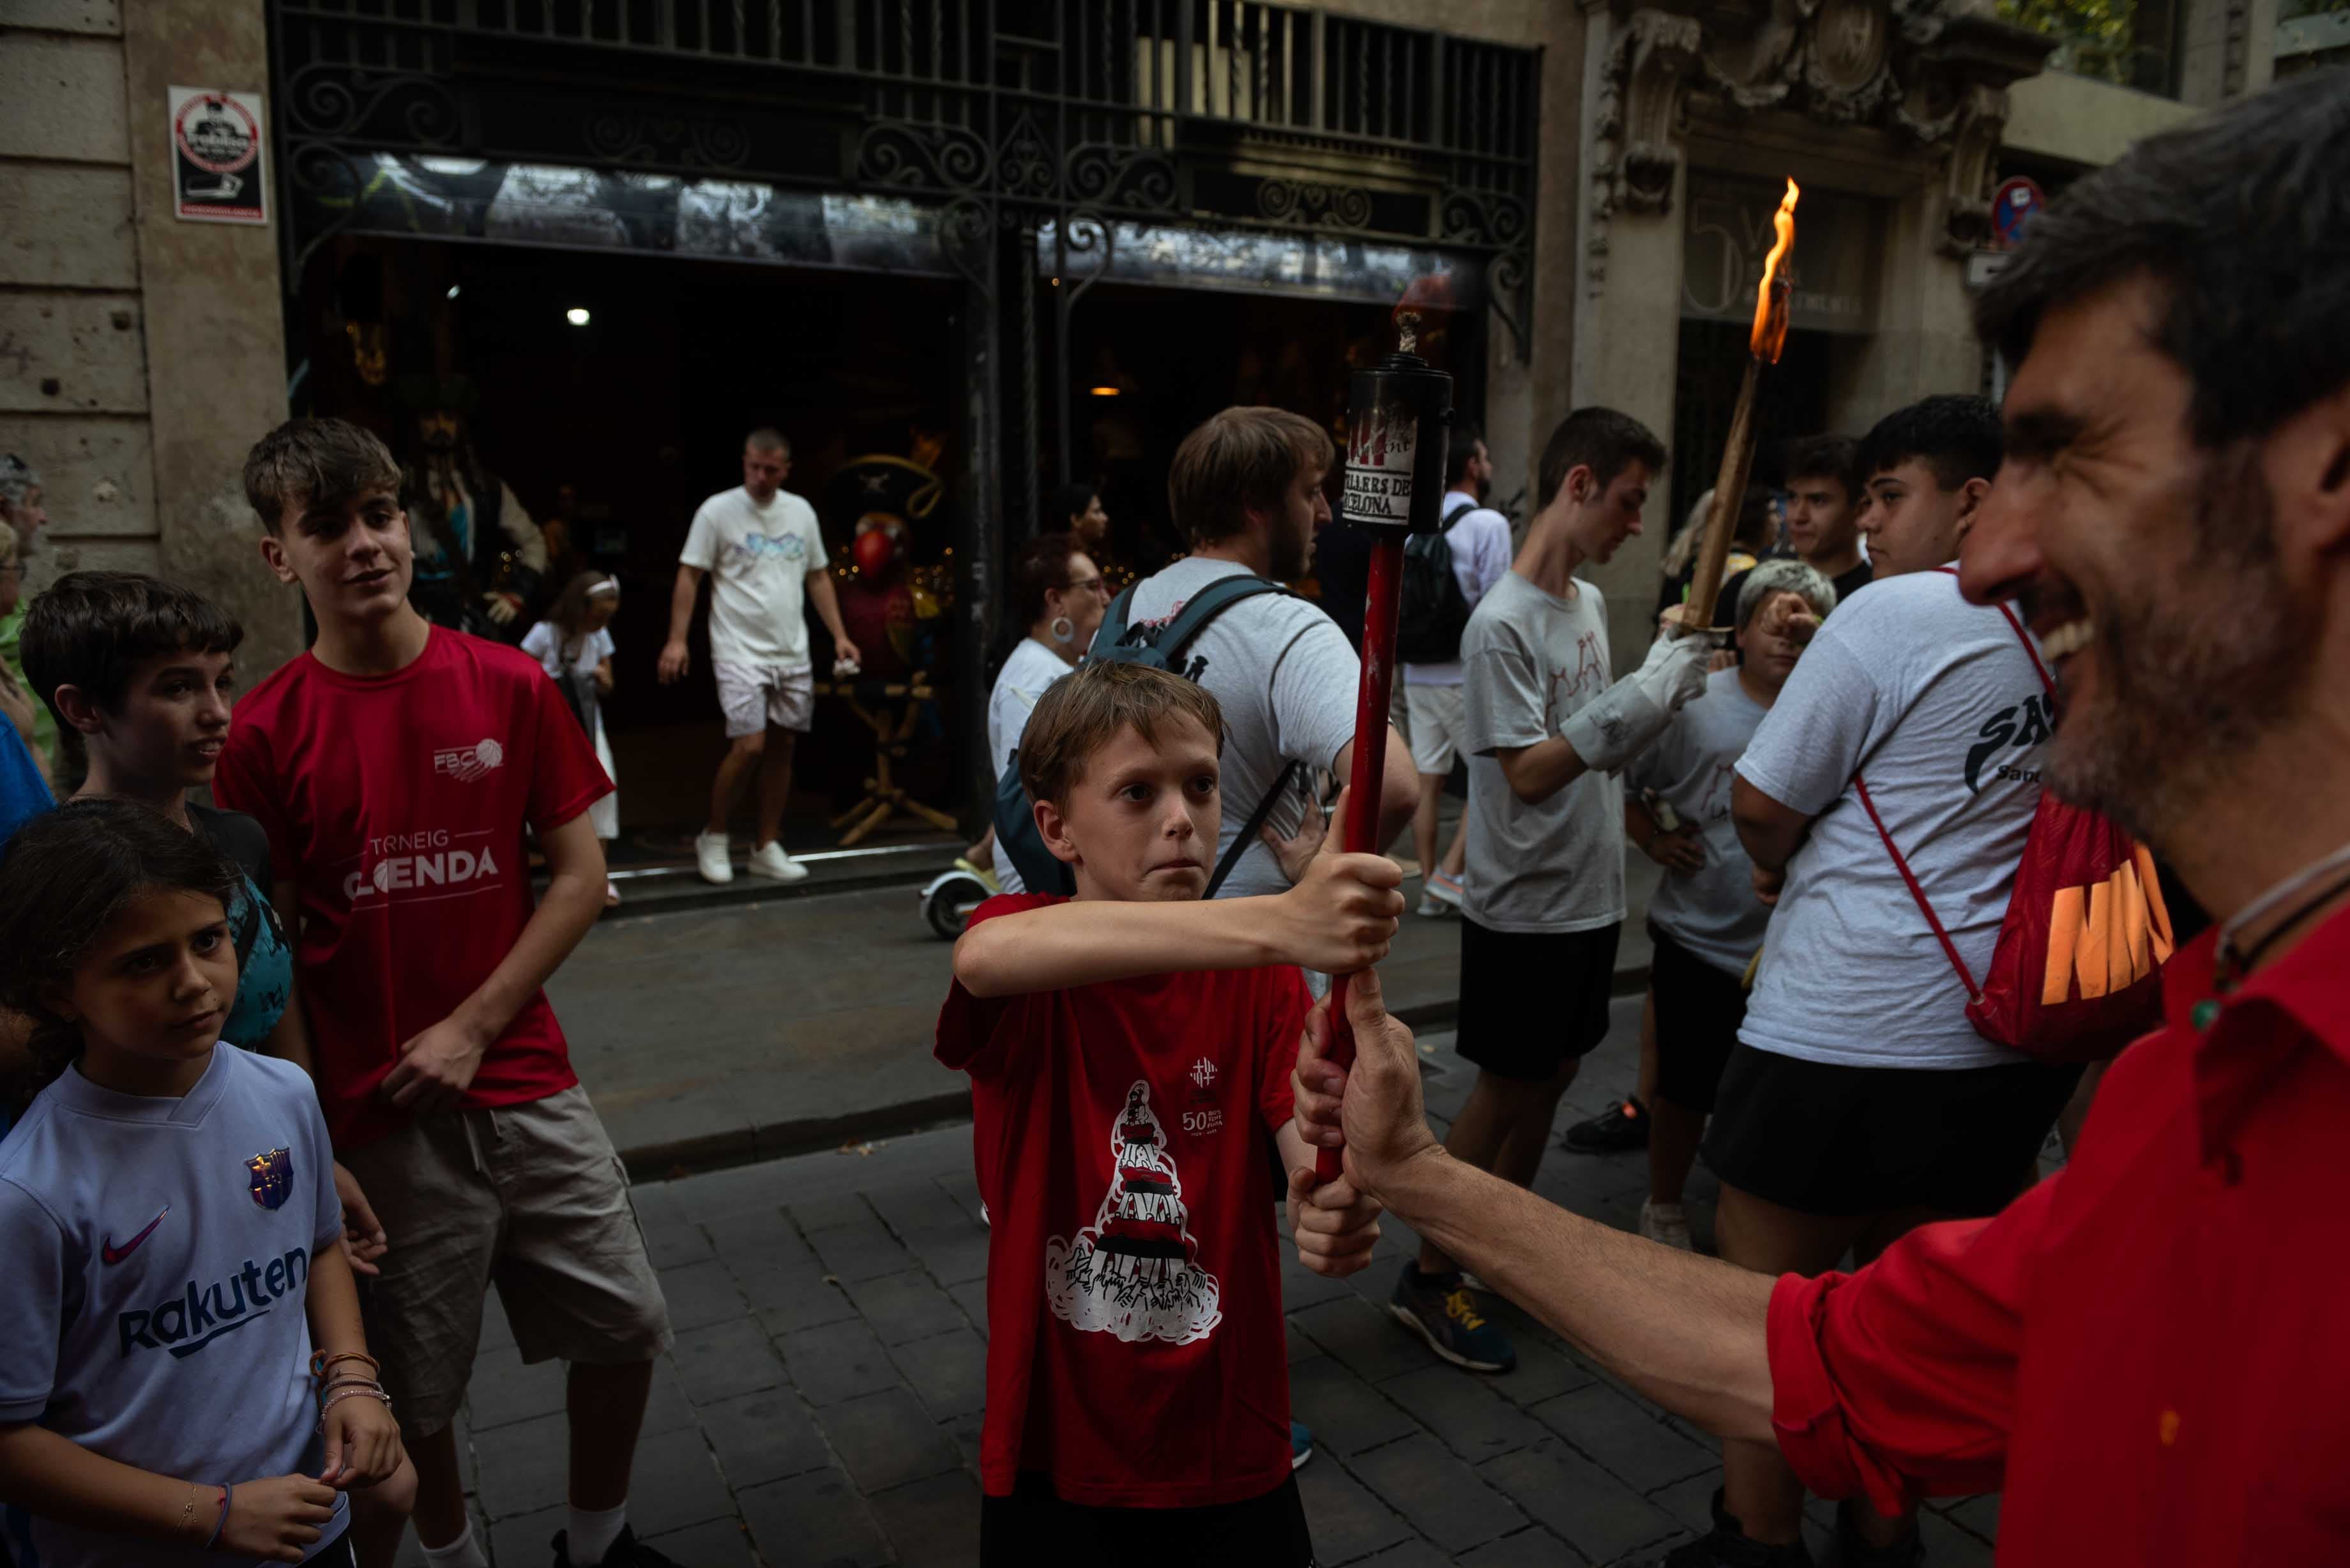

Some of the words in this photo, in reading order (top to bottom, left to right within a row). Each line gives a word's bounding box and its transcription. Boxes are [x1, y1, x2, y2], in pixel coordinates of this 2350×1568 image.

[1391, 479, 1410, 496] DE
[434, 751, 476, 770] FBC
[1183, 1111, 1206, 1131] 50
[119, 1247, 307, 1359] Rakuten
